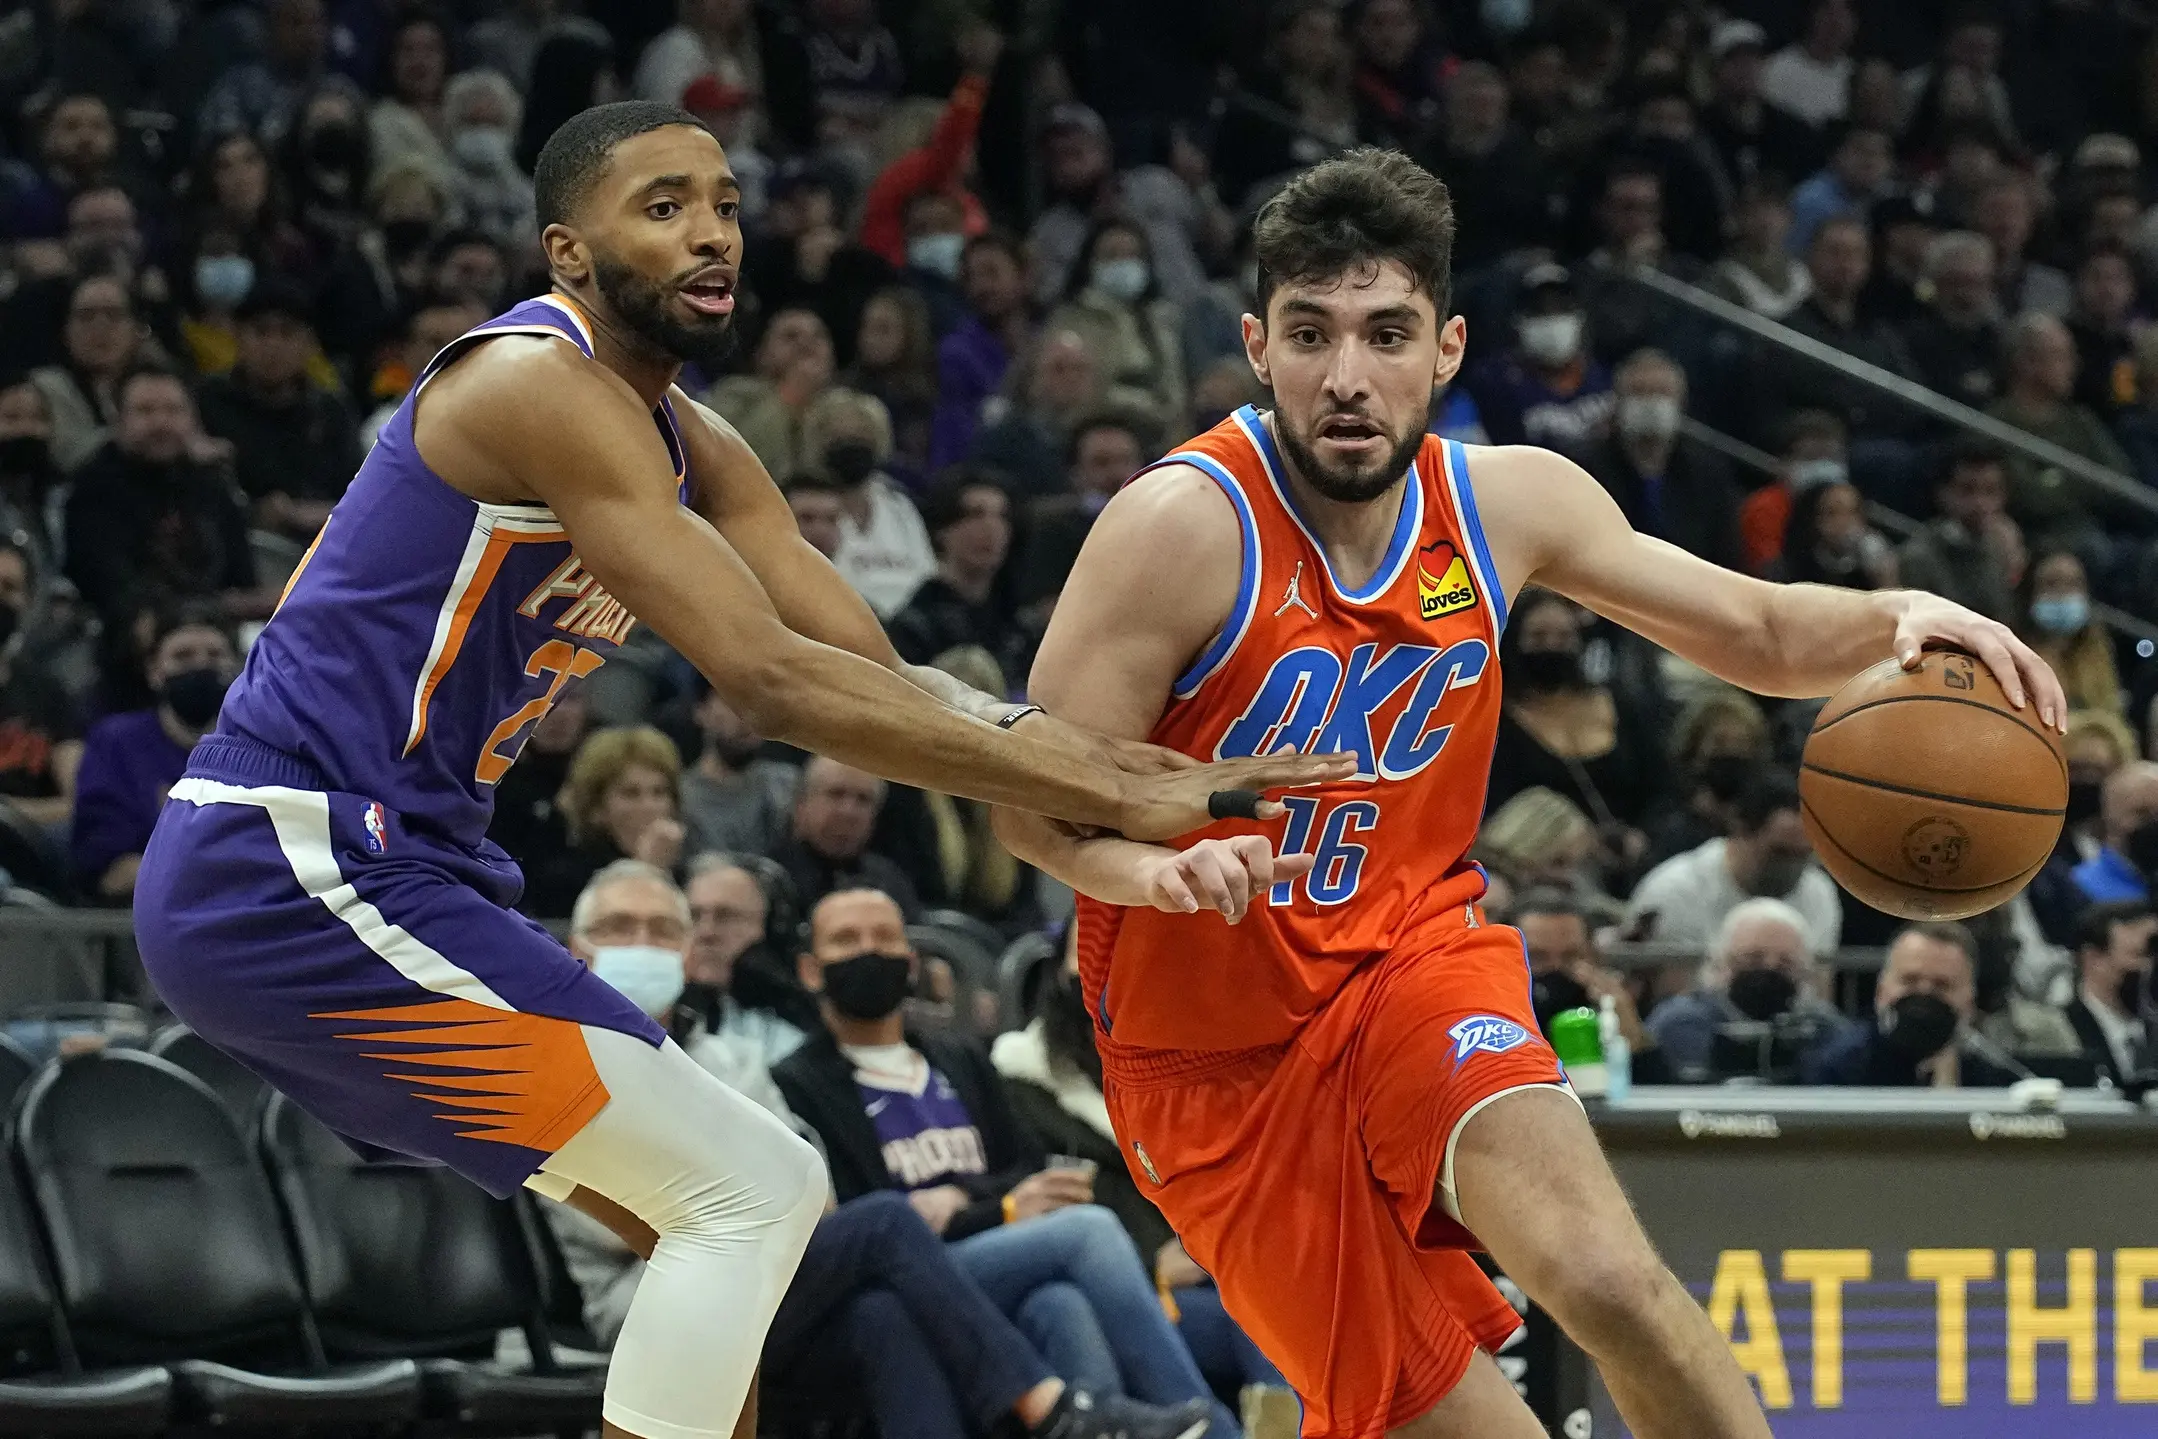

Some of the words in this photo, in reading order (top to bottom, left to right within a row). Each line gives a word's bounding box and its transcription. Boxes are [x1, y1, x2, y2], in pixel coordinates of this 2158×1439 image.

[1212, 638, 1490, 787] OKC
[1268, 795, 1381, 907] 16
[1706, 1248, 1873, 1409] AT
[1906, 1247, 2158, 1406] THE
